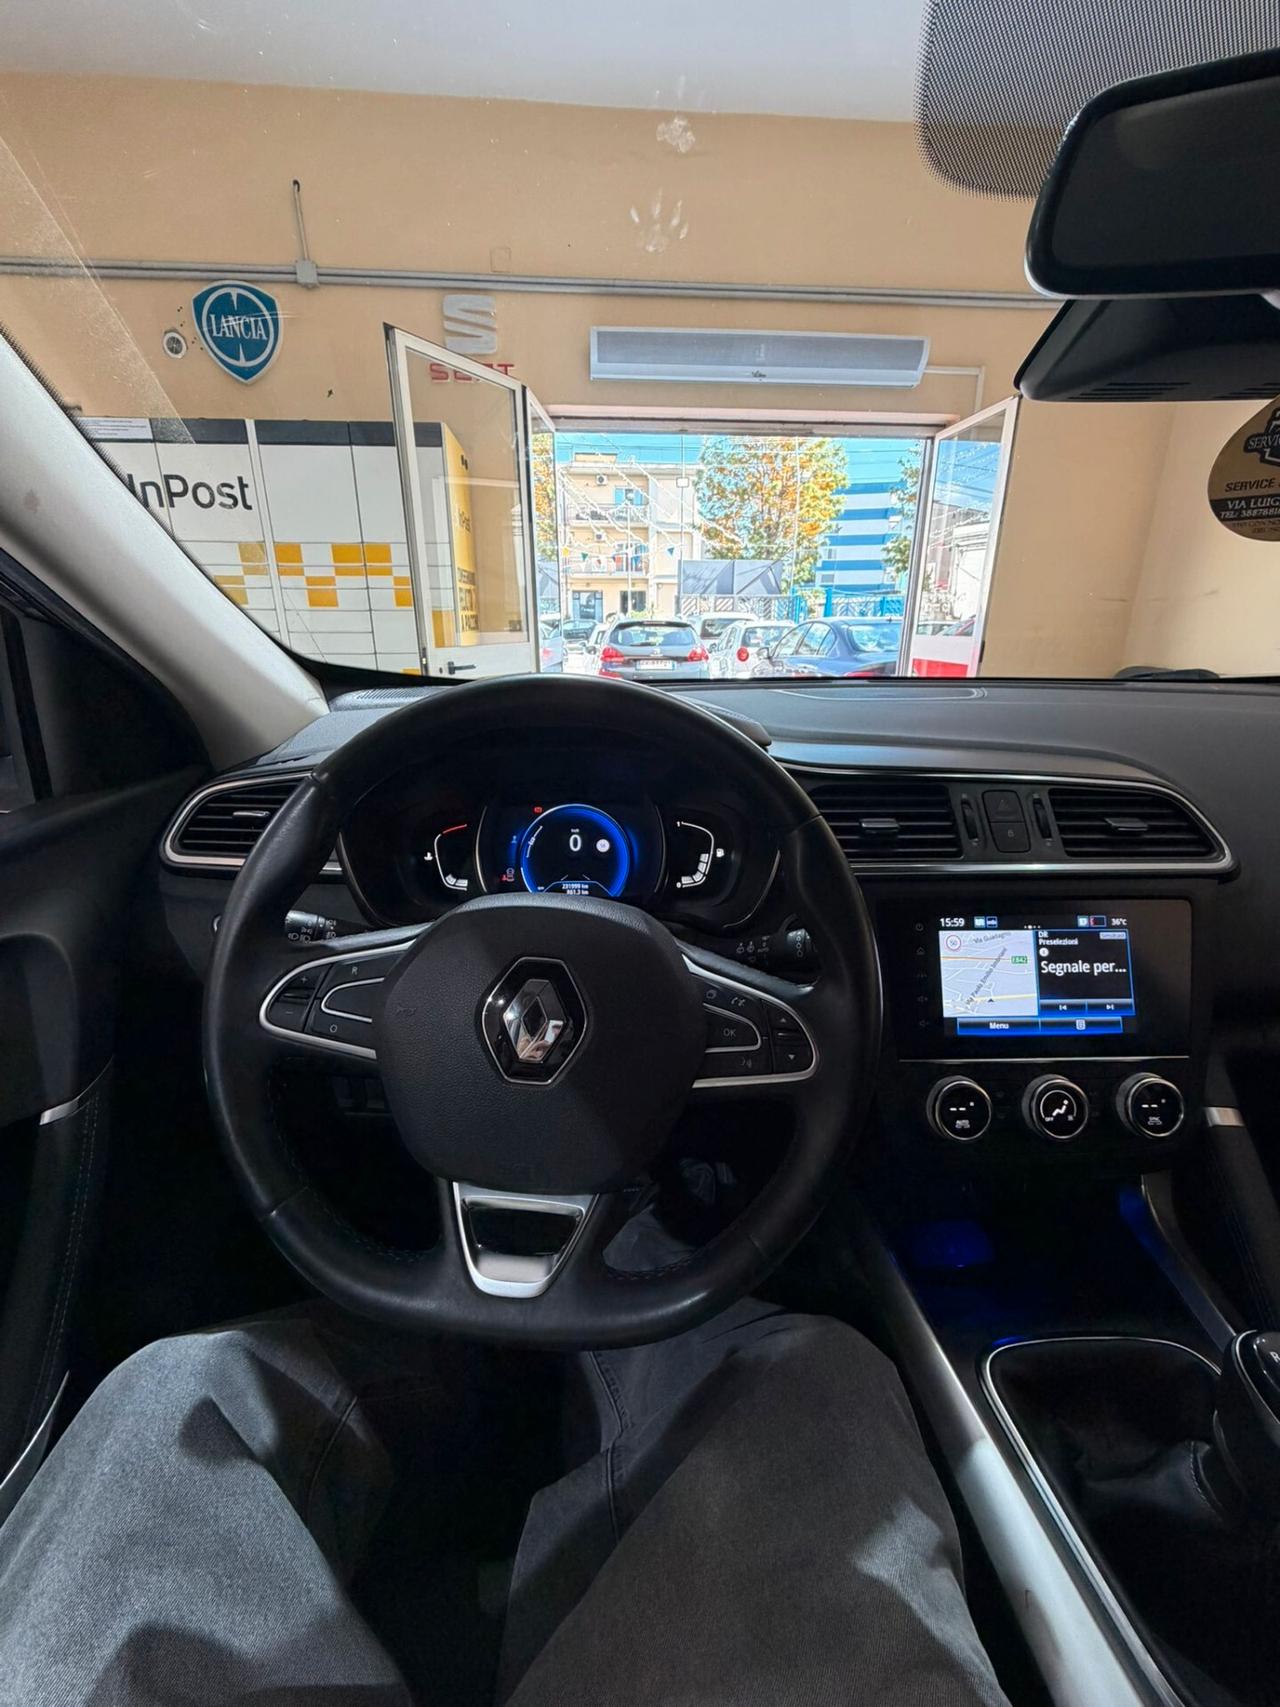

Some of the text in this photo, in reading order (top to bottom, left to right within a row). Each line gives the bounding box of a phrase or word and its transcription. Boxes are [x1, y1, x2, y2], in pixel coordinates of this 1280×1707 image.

[209, 313, 268, 340] LANCIA
[430, 363, 515, 383] SET
[1247, 434, 1280, 450] SERVI
[1224, 477, 1276, 493] SERVICE
[1226, 496, 1280, 510] VIA LUIG
[569, 834, 582, 852] 0
[939, 917, 966, 927] 15:59
[1038, 938, 1079, 946] Preselezioni
[1040, 959, 1127, 977] Segnale per...
[723, 1028, 736, 1037] OK
[989, 1022, 1010, 1030] Menu
